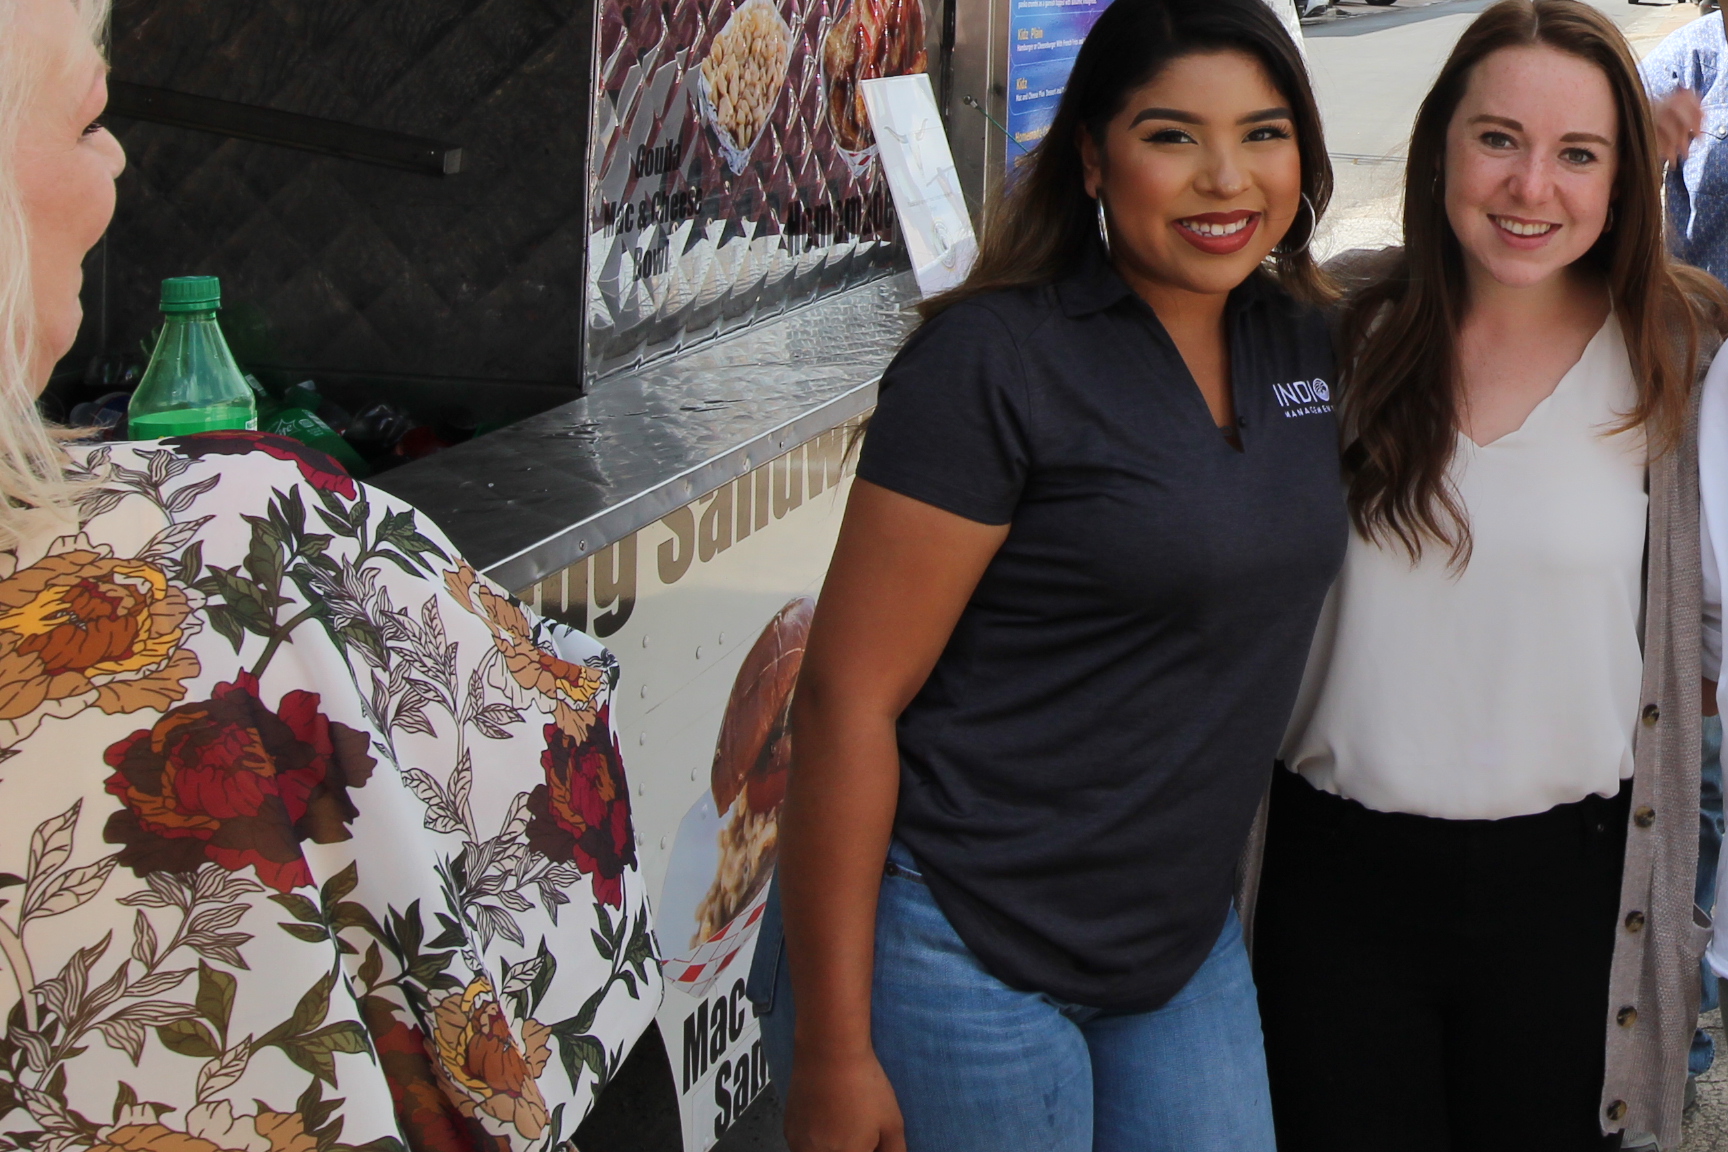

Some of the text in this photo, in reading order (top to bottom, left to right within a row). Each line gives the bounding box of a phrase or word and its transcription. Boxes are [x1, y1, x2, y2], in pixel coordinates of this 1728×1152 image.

[1018, 27, 1044, 41] Kidz Plain
[1016, 77, 1028, 91] Kidz
[635, 138, 681, 179] Gouda
[603, 185, 704, 239] Mac & Cheese
[633, 238, 670, 282] Bowl
[1272, 377, 1330, 407] INDIO
[682, 987, 746, 1096] Mac
